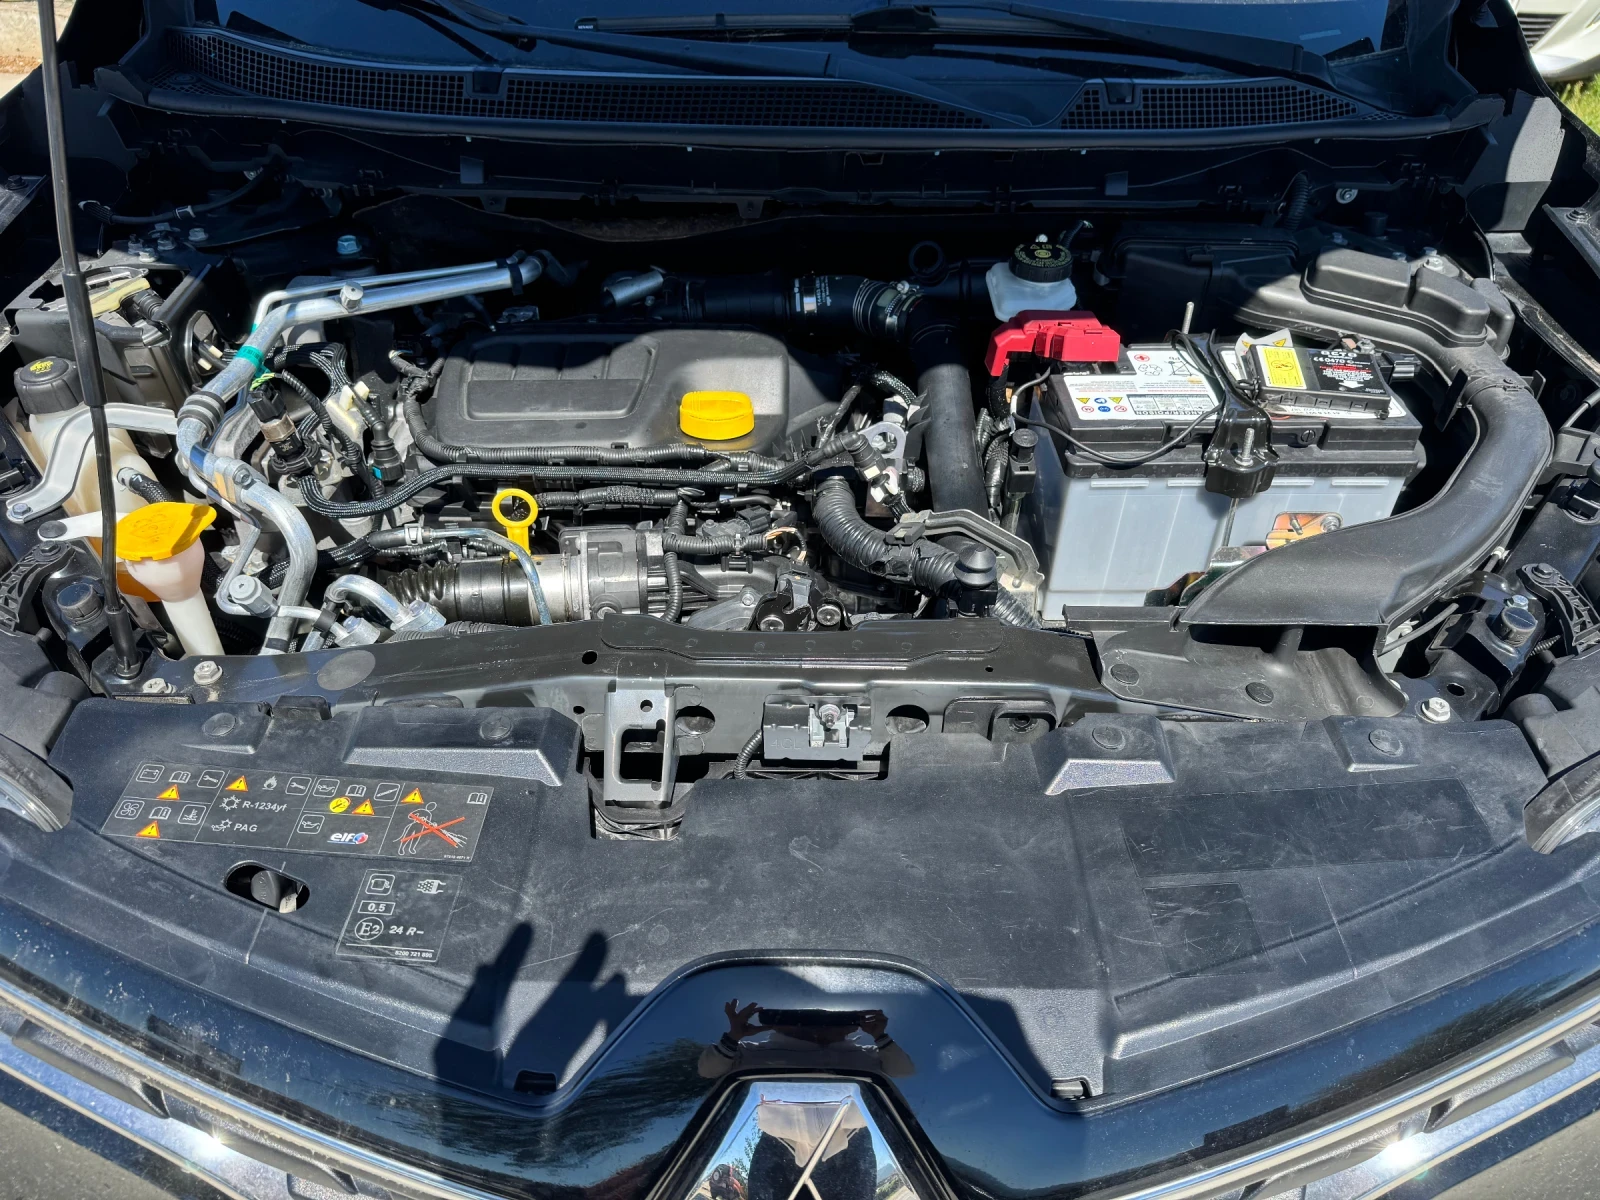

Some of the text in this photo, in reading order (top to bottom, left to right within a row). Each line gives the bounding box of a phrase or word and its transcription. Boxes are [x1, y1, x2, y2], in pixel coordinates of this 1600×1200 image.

[242, 800, 287, 813] R-1234yf
[233, 823, 258, 832] PAG
[330, 832, 356, 842] elf
[367, 903, 387, 912] 0,5
[358, 921, 380, 936] E2
[389, 925, 404, 935] 24
